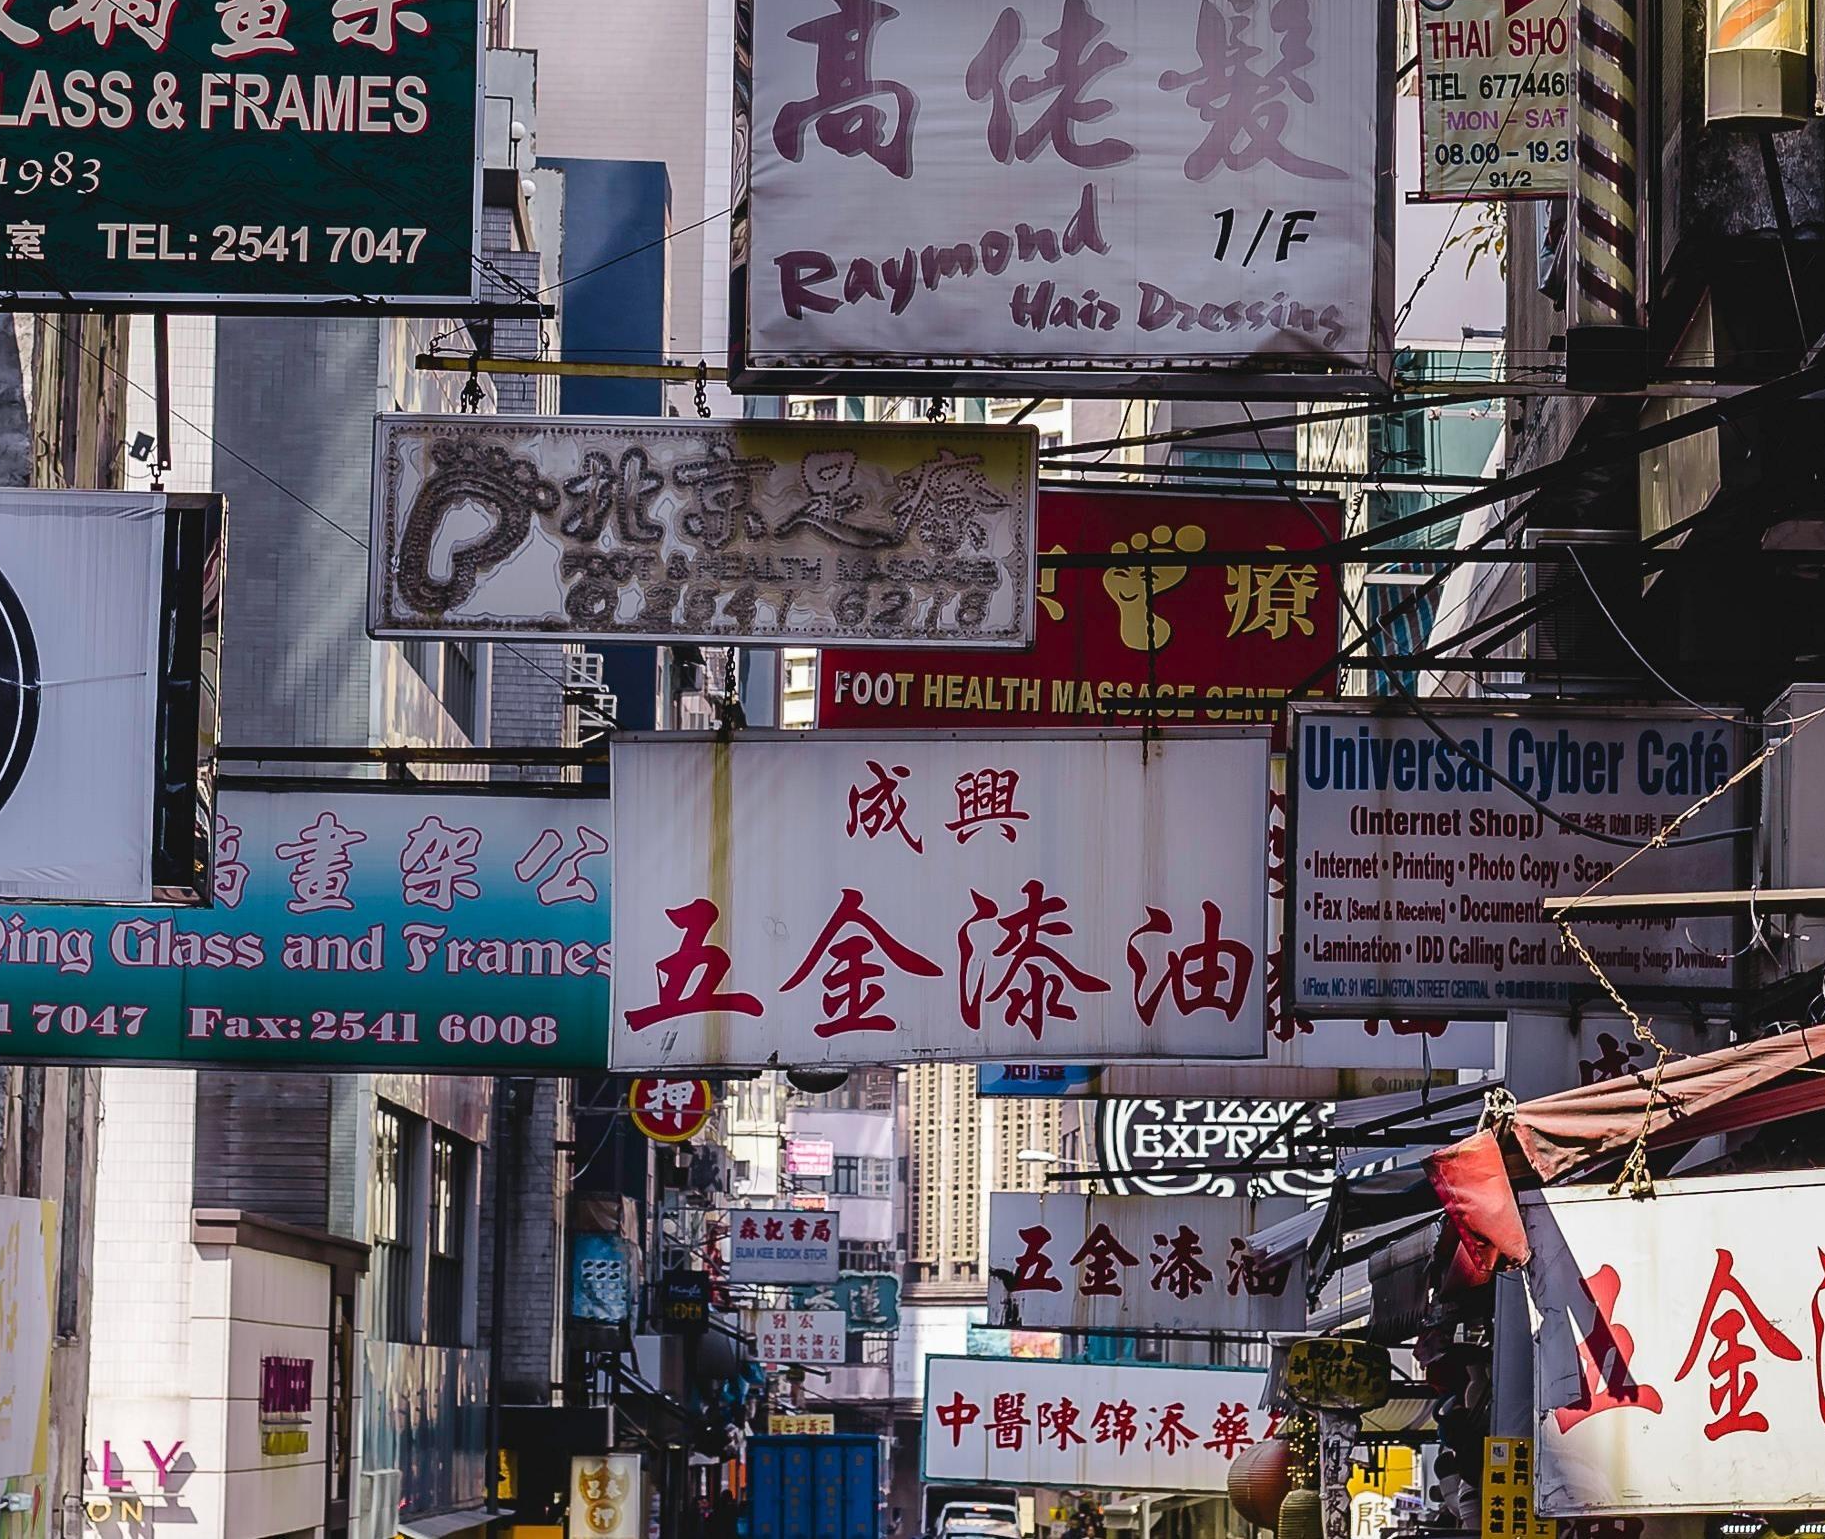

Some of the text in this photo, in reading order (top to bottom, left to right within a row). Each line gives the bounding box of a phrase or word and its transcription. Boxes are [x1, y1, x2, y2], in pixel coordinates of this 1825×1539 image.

[1426, 20, 1490, 59] THAI
[147, 77, 186, 130] &
[201, 74, 430, 134] FRAMES
[1427, 73, 1466, 101] TEL
[1447, 108, 1569, 131] MON SAT
[1435, 144, 1500, 165] 08.00
[1489, 171, 1532, 188] 91/2
[99, 222, 198, 262] TEL:
[213, 224, 315, 265] 2541
[326, 226, 428, 267] 7047
[774, 182, 1316, 321] Raymond 1/F
[1010, 281, 1121, 332] Hair
[835, 670, 1195, 718] FOOT HEALTH MASSAGE
[1305, 725, 1729, 801] Universal Cyber Café
[847, 759, 1030, 855] 成興
[1350, 805, 1544, 840] (Internet Shop)
[1314, 852, 1614, 887] Internet Printing Photo Copy Scan
[1313, 897, 1342, 922] Fax
[110, 915, 265, 971] Glass
[282, 925, 383, 973] and
[405, 923, 610, 978] Frames
[624, 879, 1255, 1042] 五金漆油
[1313, 935, 1401, 964] Lamination
[1416, 936, 1444, 964] IDD
[1448, 936, 1504, 971] Calling
[1508, 938, 1546, 966] Card
[32, 1004, 557, 1046] 7047 6008
[645, 1079, 695, 1129] 押
[740, 1217, 832, 1242] 森記書局
[1012, 1223, 1289, 1300] 五金漆油
